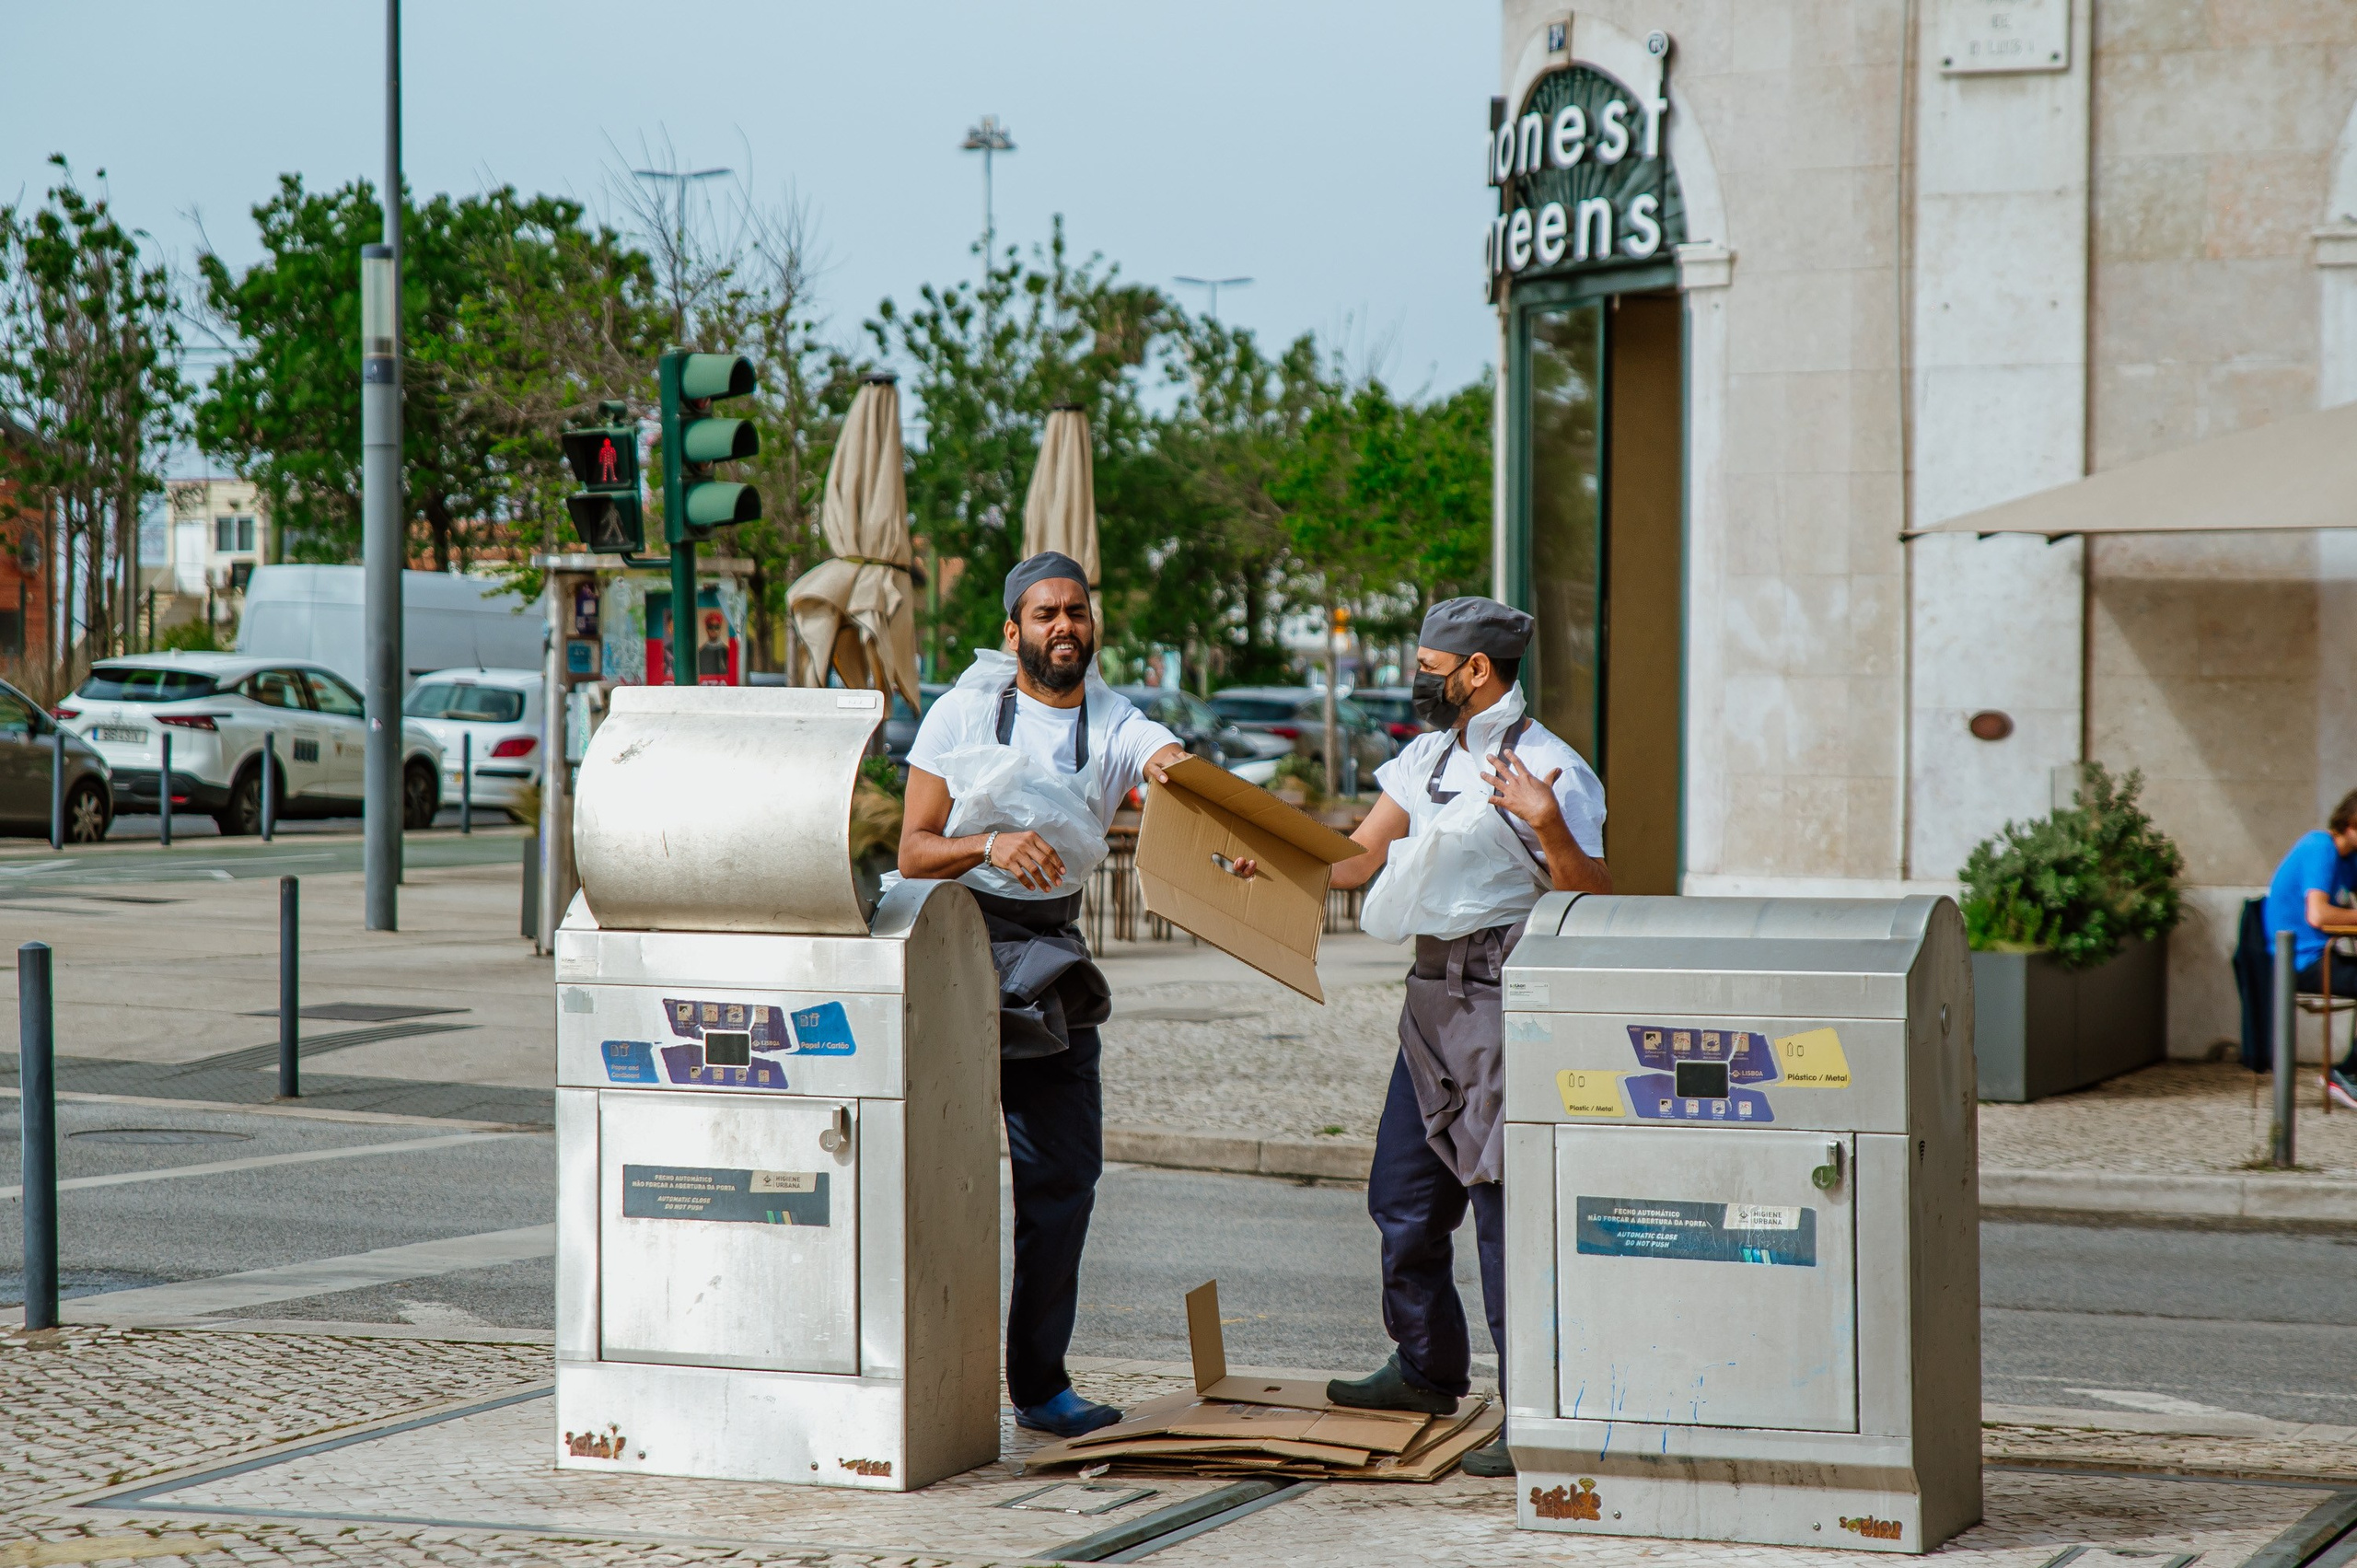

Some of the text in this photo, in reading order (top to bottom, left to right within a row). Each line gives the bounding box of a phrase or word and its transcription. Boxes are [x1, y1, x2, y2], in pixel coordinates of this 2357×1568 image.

[800, 1041, 820, 1050] Papel
[826, 1041, 850, 1050] Cartão
[1787, 1073, 1817, 1081] Plástico
[1825, 1074, 1848, 1082] Metal
[675, 1174, 713, 1183] AUTOMÁTICO
[1637, 1208, 1680, 1217] AUTOMÁTICO
[1587, 1213, 1601, 1221] NÃO
[1603, 1214, 1630, 1224] FORÇAR
[1637, 1216, 1673, 1225] ABERTURA
[1617, 1231, 1655, 1239] AUTOMATIC
